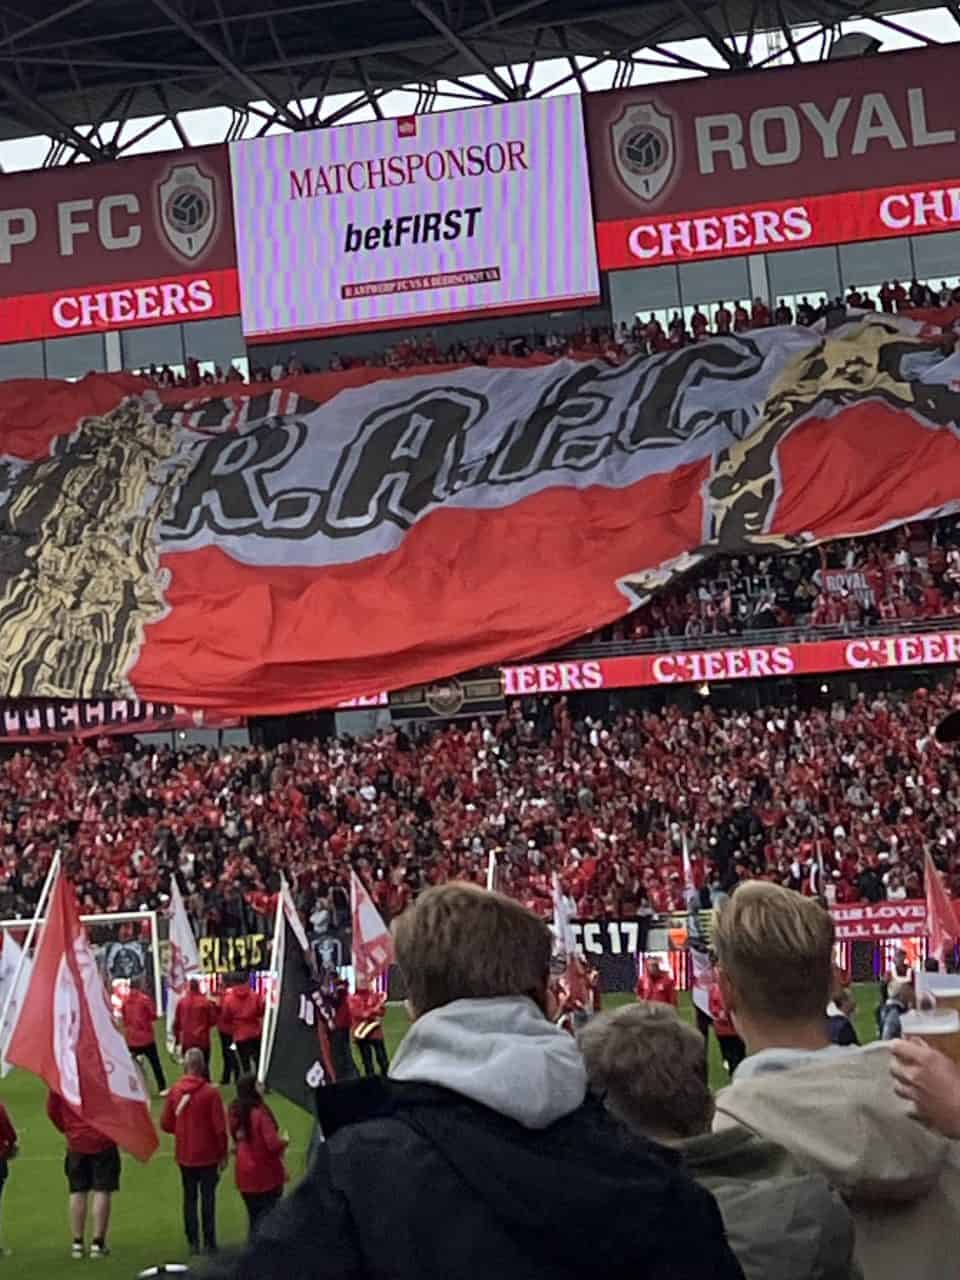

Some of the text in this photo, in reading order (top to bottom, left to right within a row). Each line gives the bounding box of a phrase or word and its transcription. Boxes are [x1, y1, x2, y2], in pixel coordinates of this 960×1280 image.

[694, 87, 956, 175] ROYAL
[289, 140, 528, 200] MATCHSPONSOR
[57, 193, 141, 256] FC
[344, 207, 482, 252] betFIRST
[628, 206, 812, 258] CHEERS
[52, 279, 214, 328] CHEERS
[652, 646, 796, 684] CHEERS
[865, 905, 926, 920] LOVE
[607, 922, 639, 955] 17
